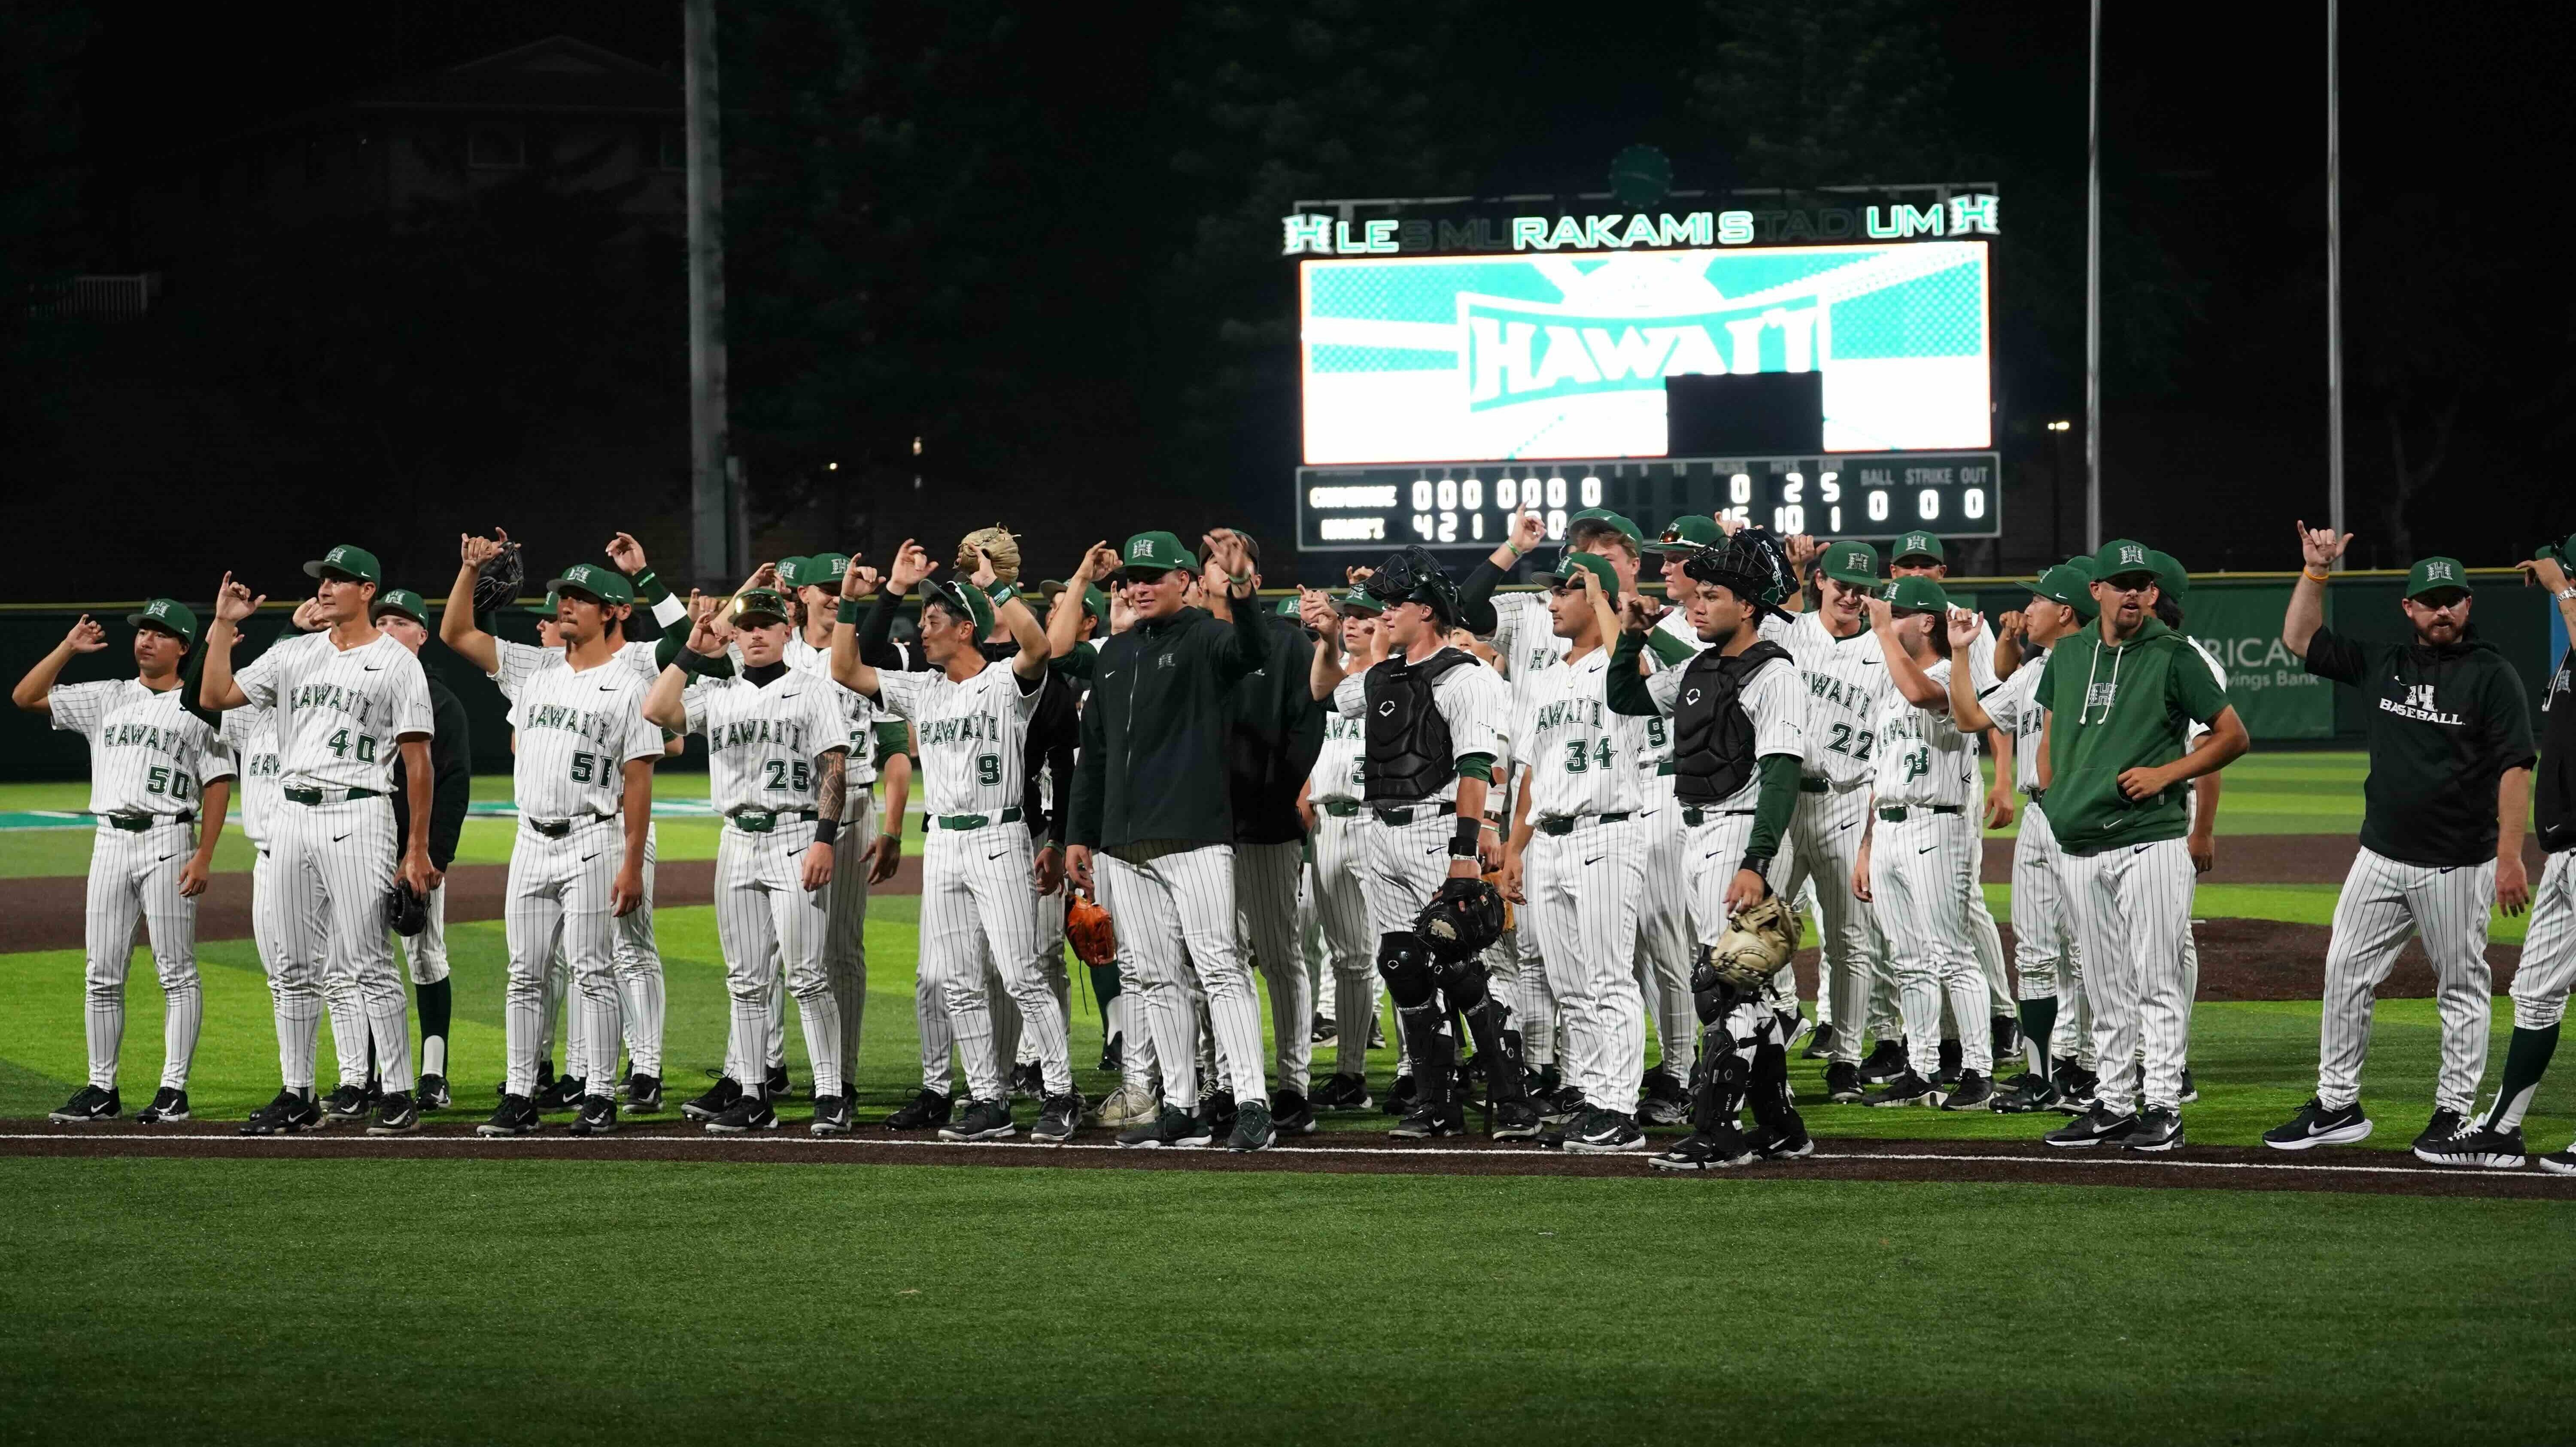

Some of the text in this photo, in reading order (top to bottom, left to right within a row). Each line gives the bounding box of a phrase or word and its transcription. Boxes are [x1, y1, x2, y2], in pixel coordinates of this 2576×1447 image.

[1413, 481, 1432, 511] 0
[1437, 480, 1457, 510] 0
[1462, 479, 1482, 509] 0
[1497, 479, 1516, 509] 0
[1522, 478, 1542, 508] 0
[1547, 477, 1567, 508] 0
[1581, 477, 1601, 507] 0
[1731, 474, 1750, 504] 0
[1784, 472, 1804, 502] 2
[1820, 472, 1840, 502] 5
[1860, 466, 1988, 486] BALL STRIKE OUT
[1413, 514, 1433, 541] 4
[1437, 512, 1458, 542] 2
[1473, 513, 1482, 540] 1
[1547, 510, 1567, 540] 0
[1774, 505, 1804, 535] 10
[1831, 506, 1841, 532] 1
[1868, 488, 1984, 521] 0 0 0
[1801, 670, 1872, 722] WAI'I
[2226, 669, 2319, 690] vings Bank
[290, 682, 373, 726] HAWAI'I
[1536, 695, 1603, 734] AWAI'I
[2379, 698, 2463, 725] BASEBALL
[104, 723, 190, 765] HAWAI'I
[525, 702, 609, 748] HAWAI'I
[710, 717, 801, 755] HAWAI'I
[920, 711, 1000, 746] HAWAI'I
[1824, 721, 1874, 762] 22
[327, 727, 379, 765] 40
[1565, 735, 1618, 773] 34
[147, 764, 192, 802] 50
[570, 750, 614, 788] 51
[764, 759, 810, 792] 25
[977, 753, 1002, 786] 9
